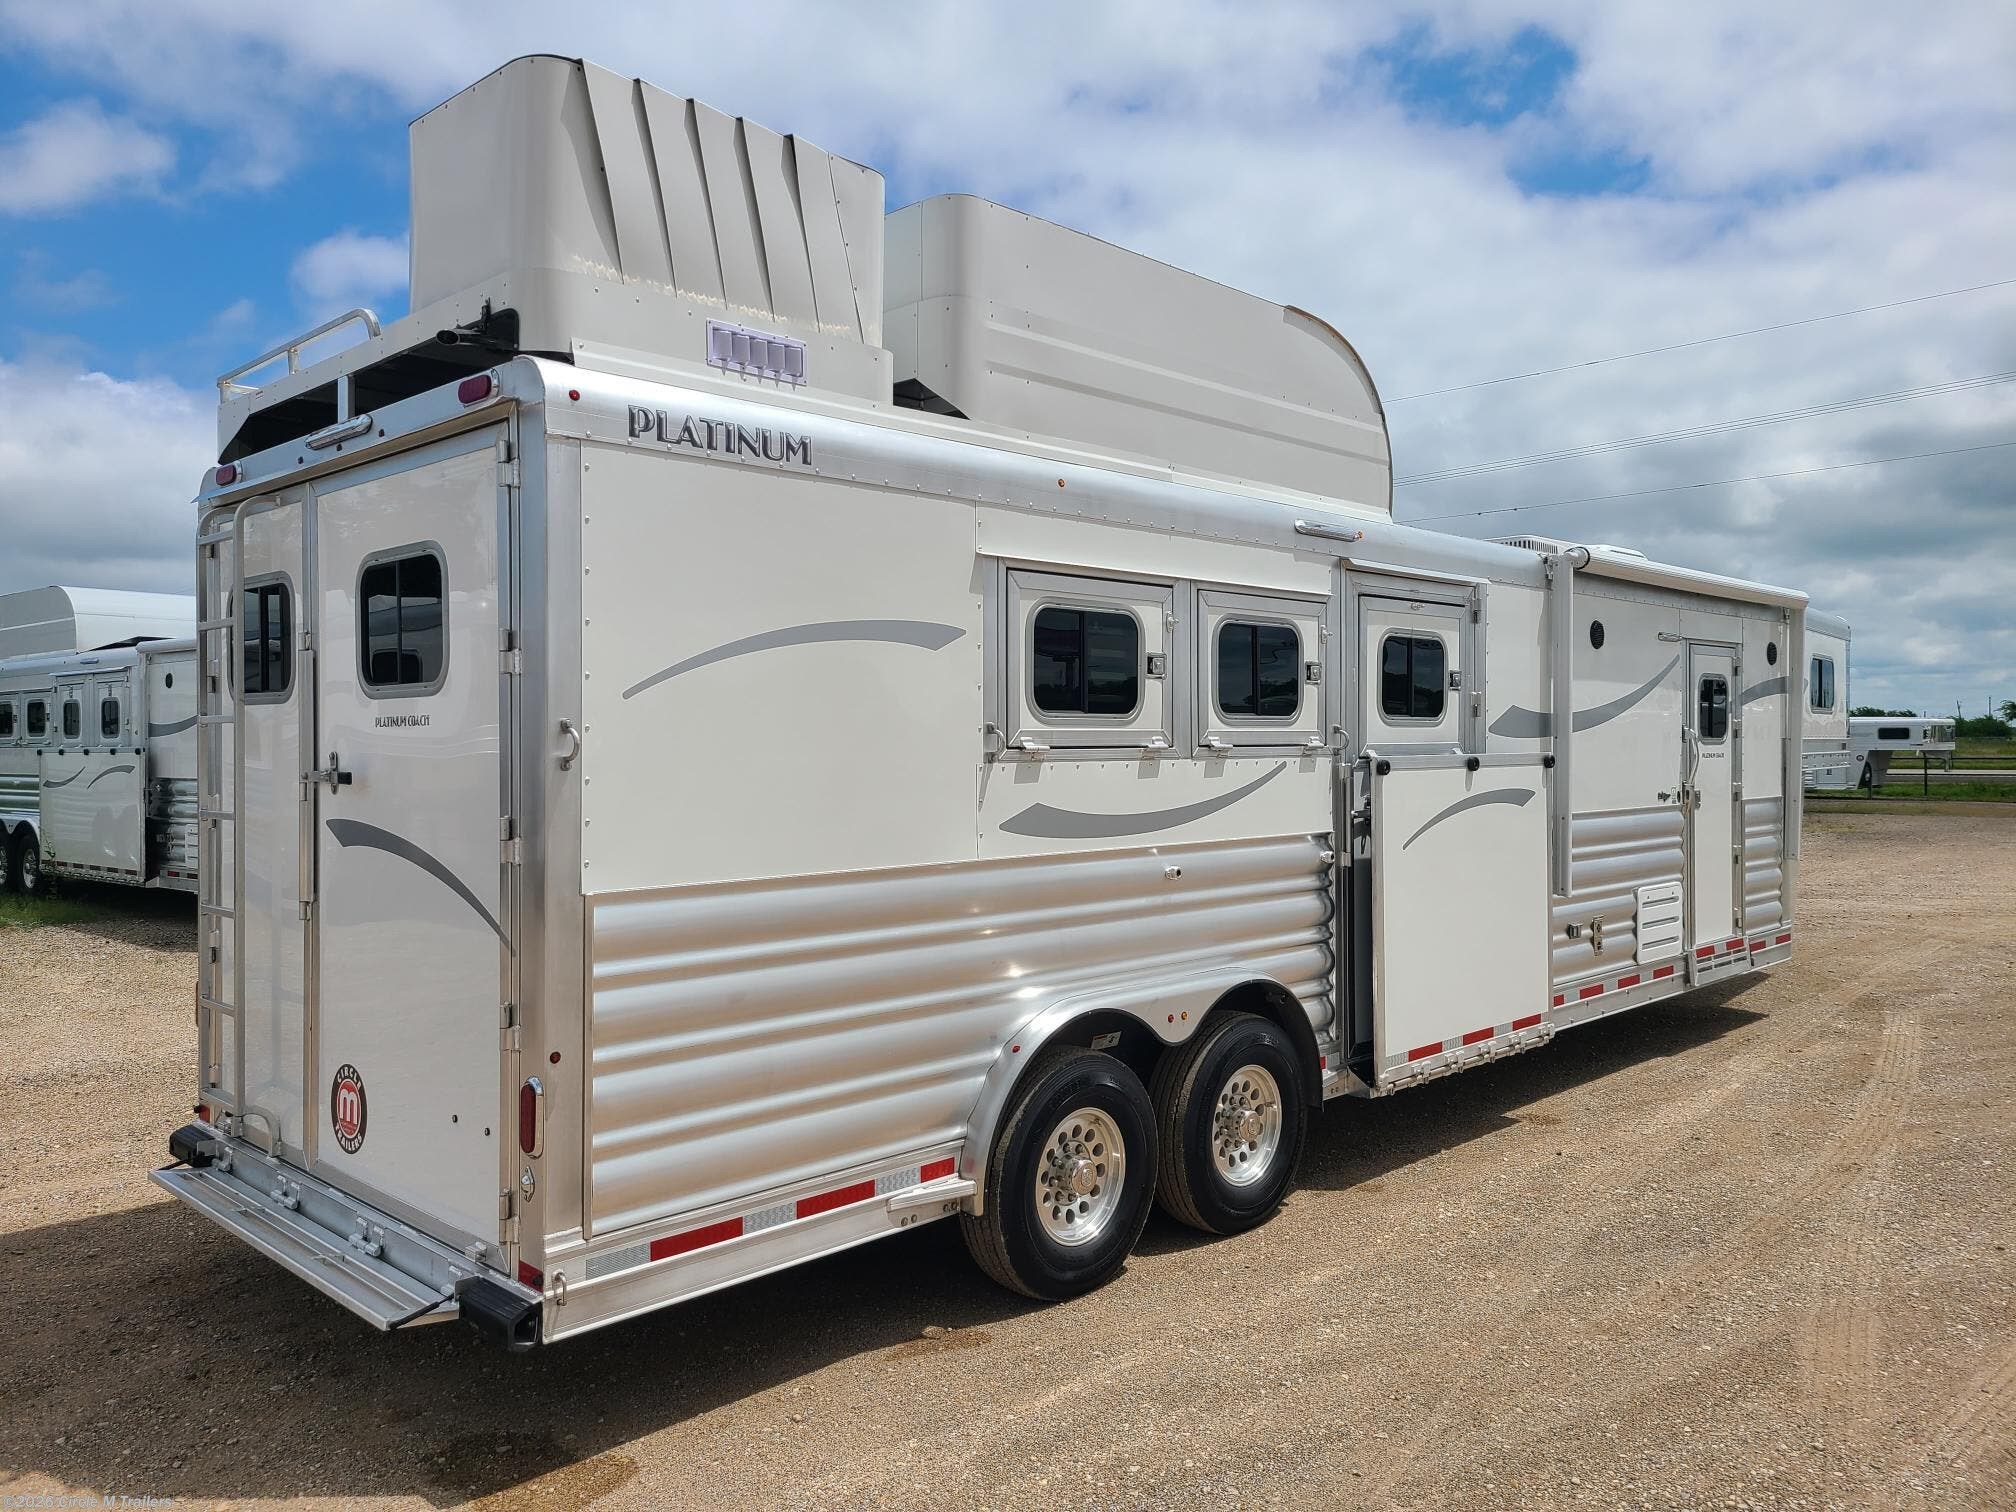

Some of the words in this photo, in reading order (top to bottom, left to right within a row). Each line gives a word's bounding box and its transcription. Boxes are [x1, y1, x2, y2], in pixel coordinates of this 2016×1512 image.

[627, 404, 812, 466] PLATINUM
[375, 716, 407, 728] PLATINUM
[408, 714, 430, 727] COACH
[337, 1066, 362, 1090] CIRCLE
[335, 1121, 362, 1151] TRAILERS
